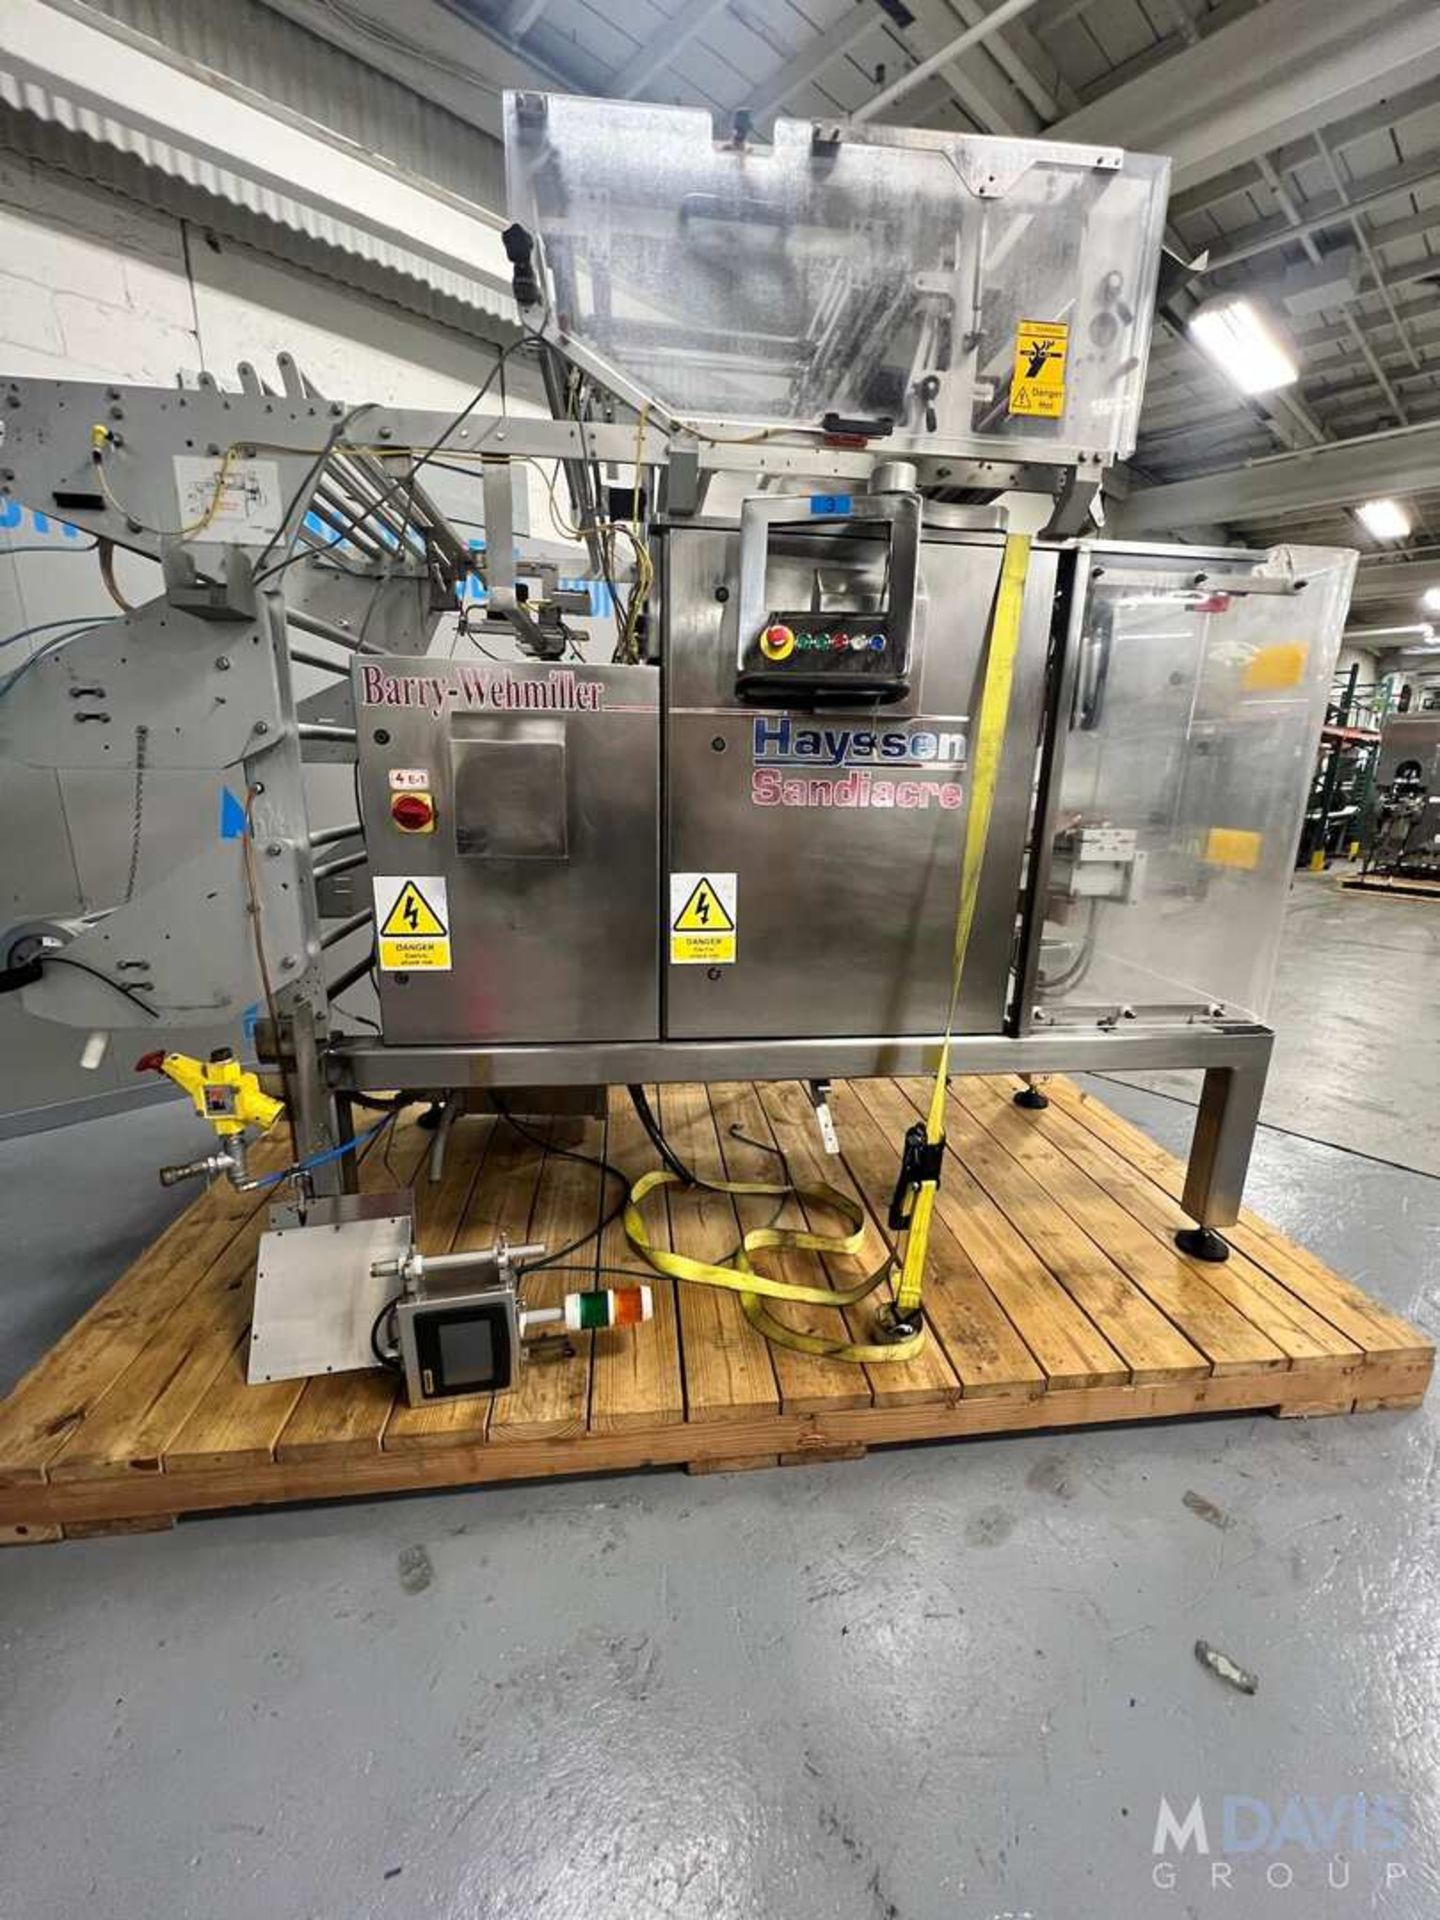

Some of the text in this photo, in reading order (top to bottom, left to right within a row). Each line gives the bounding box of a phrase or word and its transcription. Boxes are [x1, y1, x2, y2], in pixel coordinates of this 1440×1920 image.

[824, 497, 835, 512] 3
[362, 664, 604, 720] Barry-Wehmiller
[753, 716, 967, 768] Hayssen
[751, 767, 963, 809] Sandiacre
[396, 943, 435, 952] DANGER
